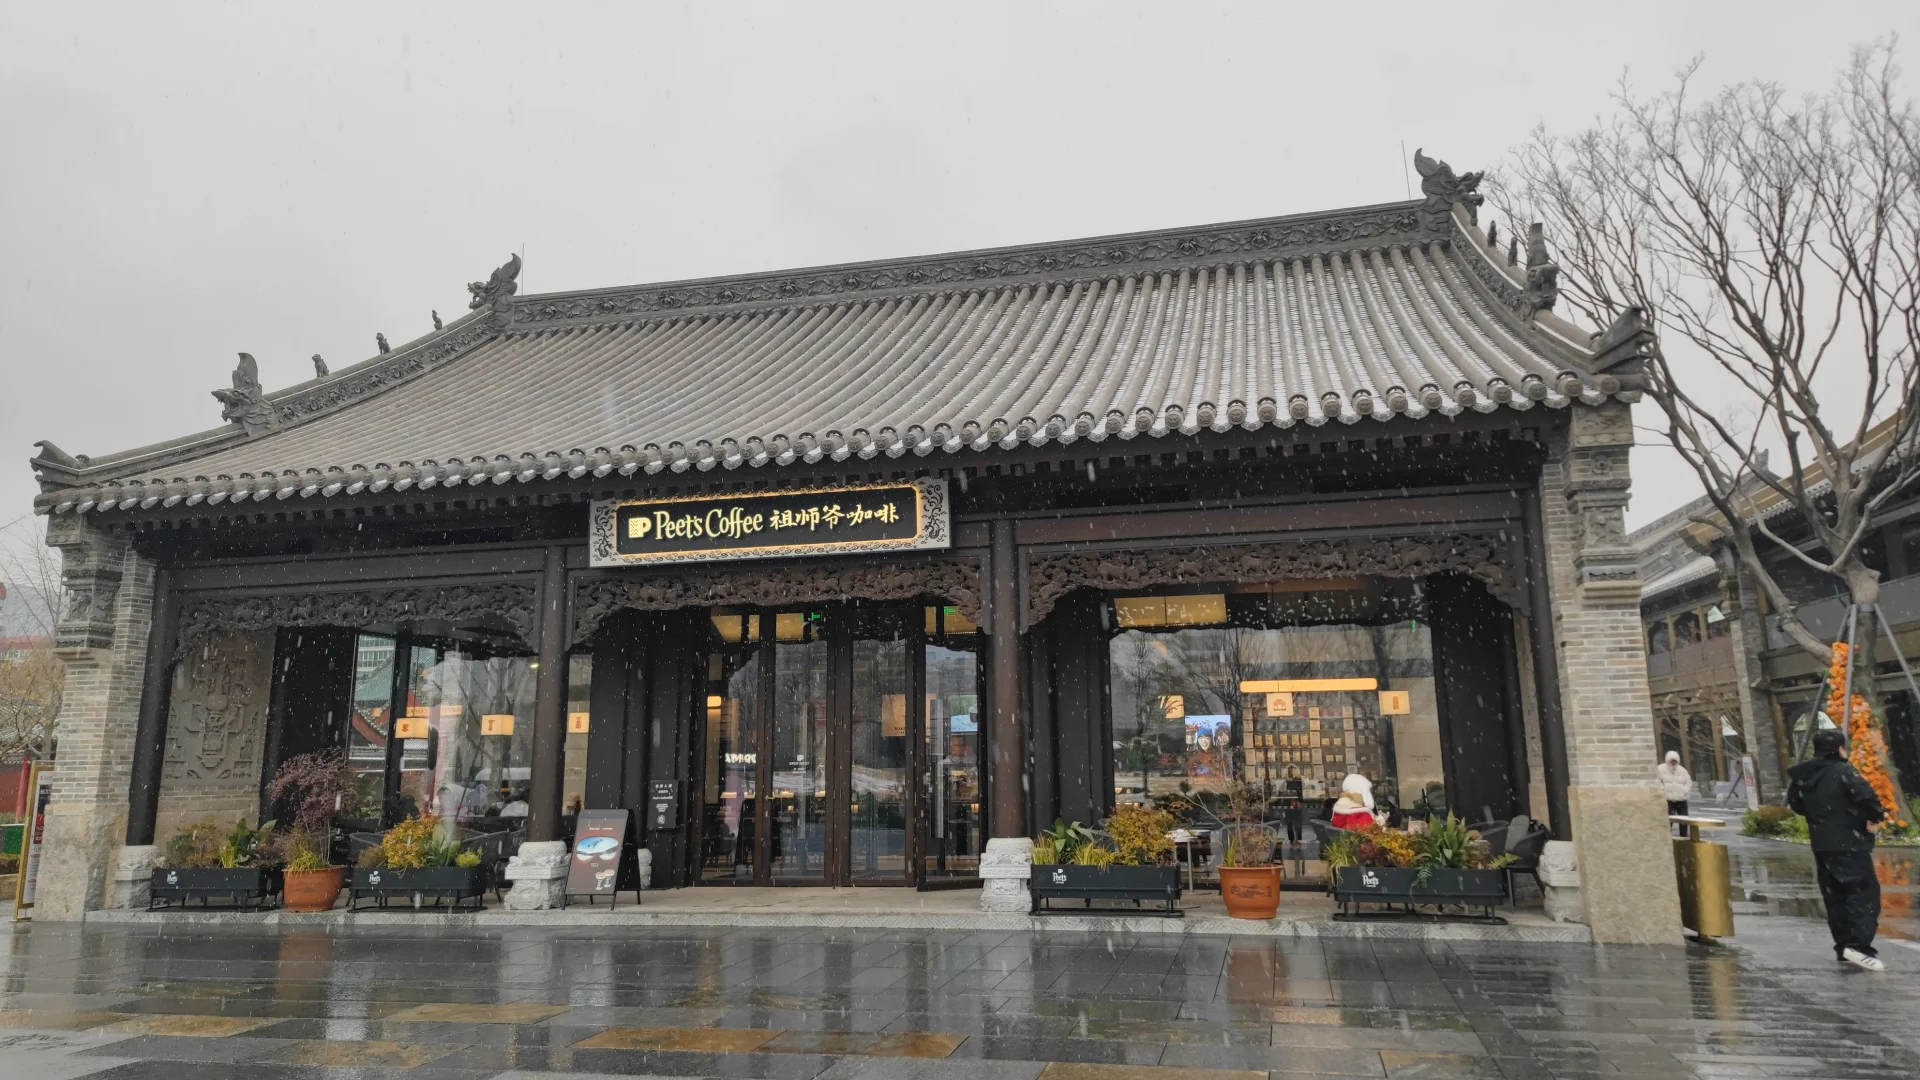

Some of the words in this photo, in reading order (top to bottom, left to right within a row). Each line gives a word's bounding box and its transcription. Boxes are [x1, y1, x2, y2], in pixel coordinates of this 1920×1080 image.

[653, 511, 702, 539] Peet's
[705, 507, 763, 538] Coffee
[769, 503, 899, 531] 祖师爷咖啡
